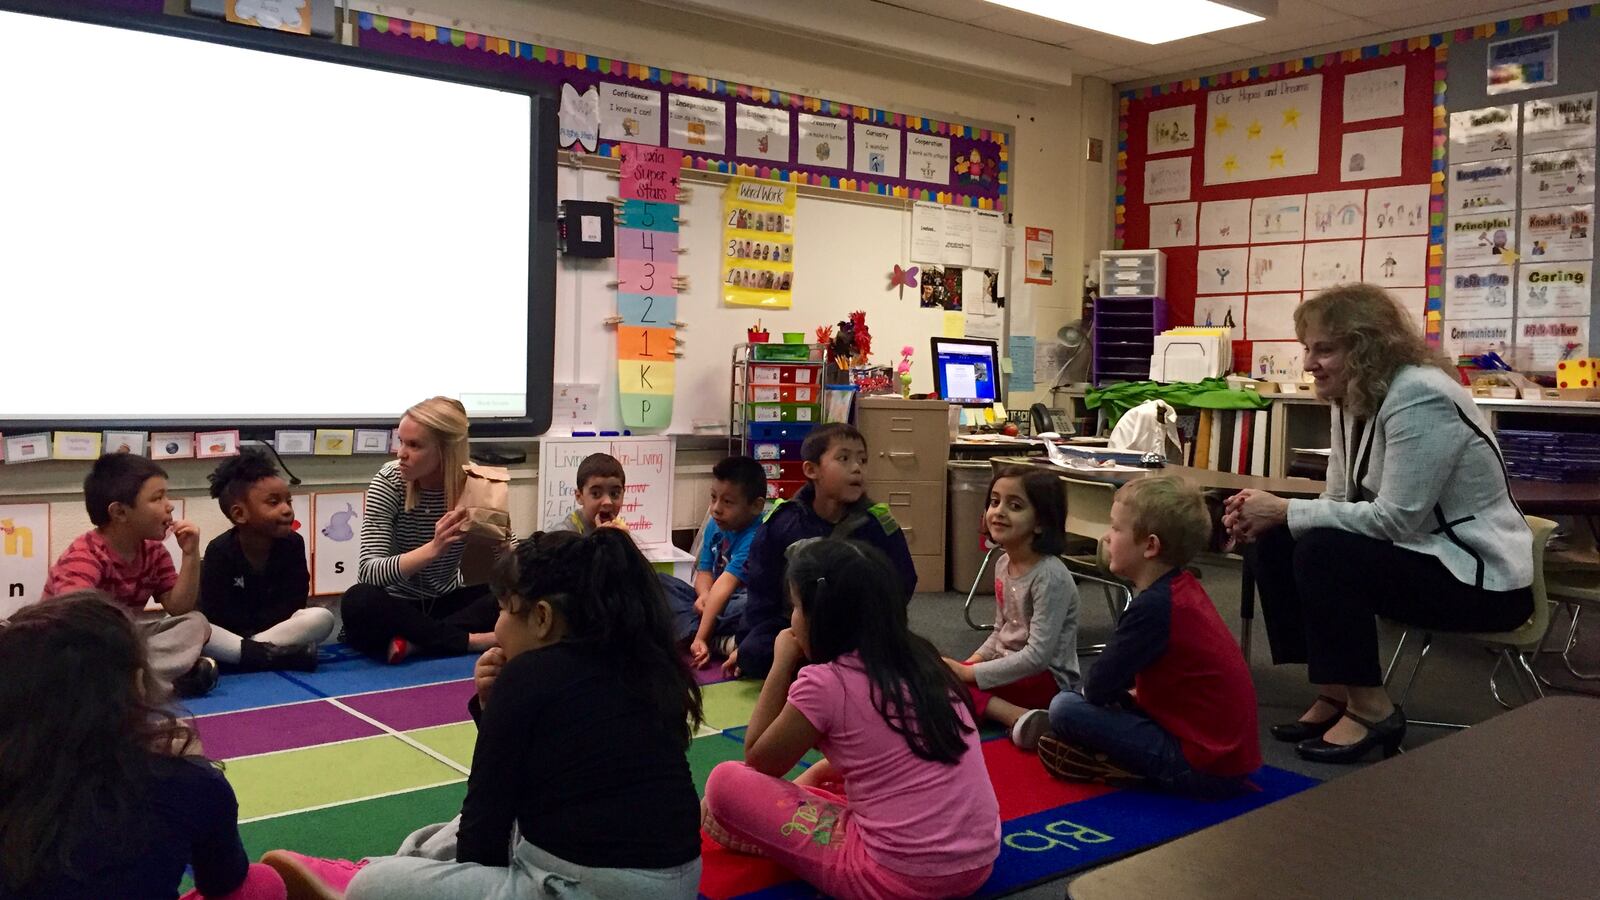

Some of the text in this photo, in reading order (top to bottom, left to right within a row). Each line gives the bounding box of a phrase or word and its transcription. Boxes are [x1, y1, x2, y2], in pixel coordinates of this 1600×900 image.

[612, 88, 649, 102] Confidence
[1216, 82, 1310, 104] Our Hopes and Dreams
[616, 104, 632, 112] know
[634, 106, 638, 114] I
[810, 120, 837, 129] eativity
[866, 129, 888, 140] Curiosity
[915, 138, 942, 148] Cooperation
[634, 165, 668, 186] Super
[636, 182, 668, 200] Stars
[740, 184, 784, 204] Word Work
[642, 204, 657, 226] 5
[728, 210, 738, 226] 2
[642, 232, 654, 262] 4
[728, 239, 737, 257] 3
[640, 263, 656, 291] 3
[726, 268, 734, 286] 1
[1528, 271, 1584, 284] Caring
[640, 296, 656, 323] 2
[1451, 327, 1506, 340] Communicator
[640, 330, 652, 356] 1
[640, 364, 652, 389] K
[642, 400, 651, 422] P
[555, 446, 590, 468] Livin
[612, 446, 663, 474] Non-Living
[626, 484, 646, 494] row
[335, 561, 344, 574] s
[10, 582, 24, 597] n
[1004, 820, 1116, 852] Bb
